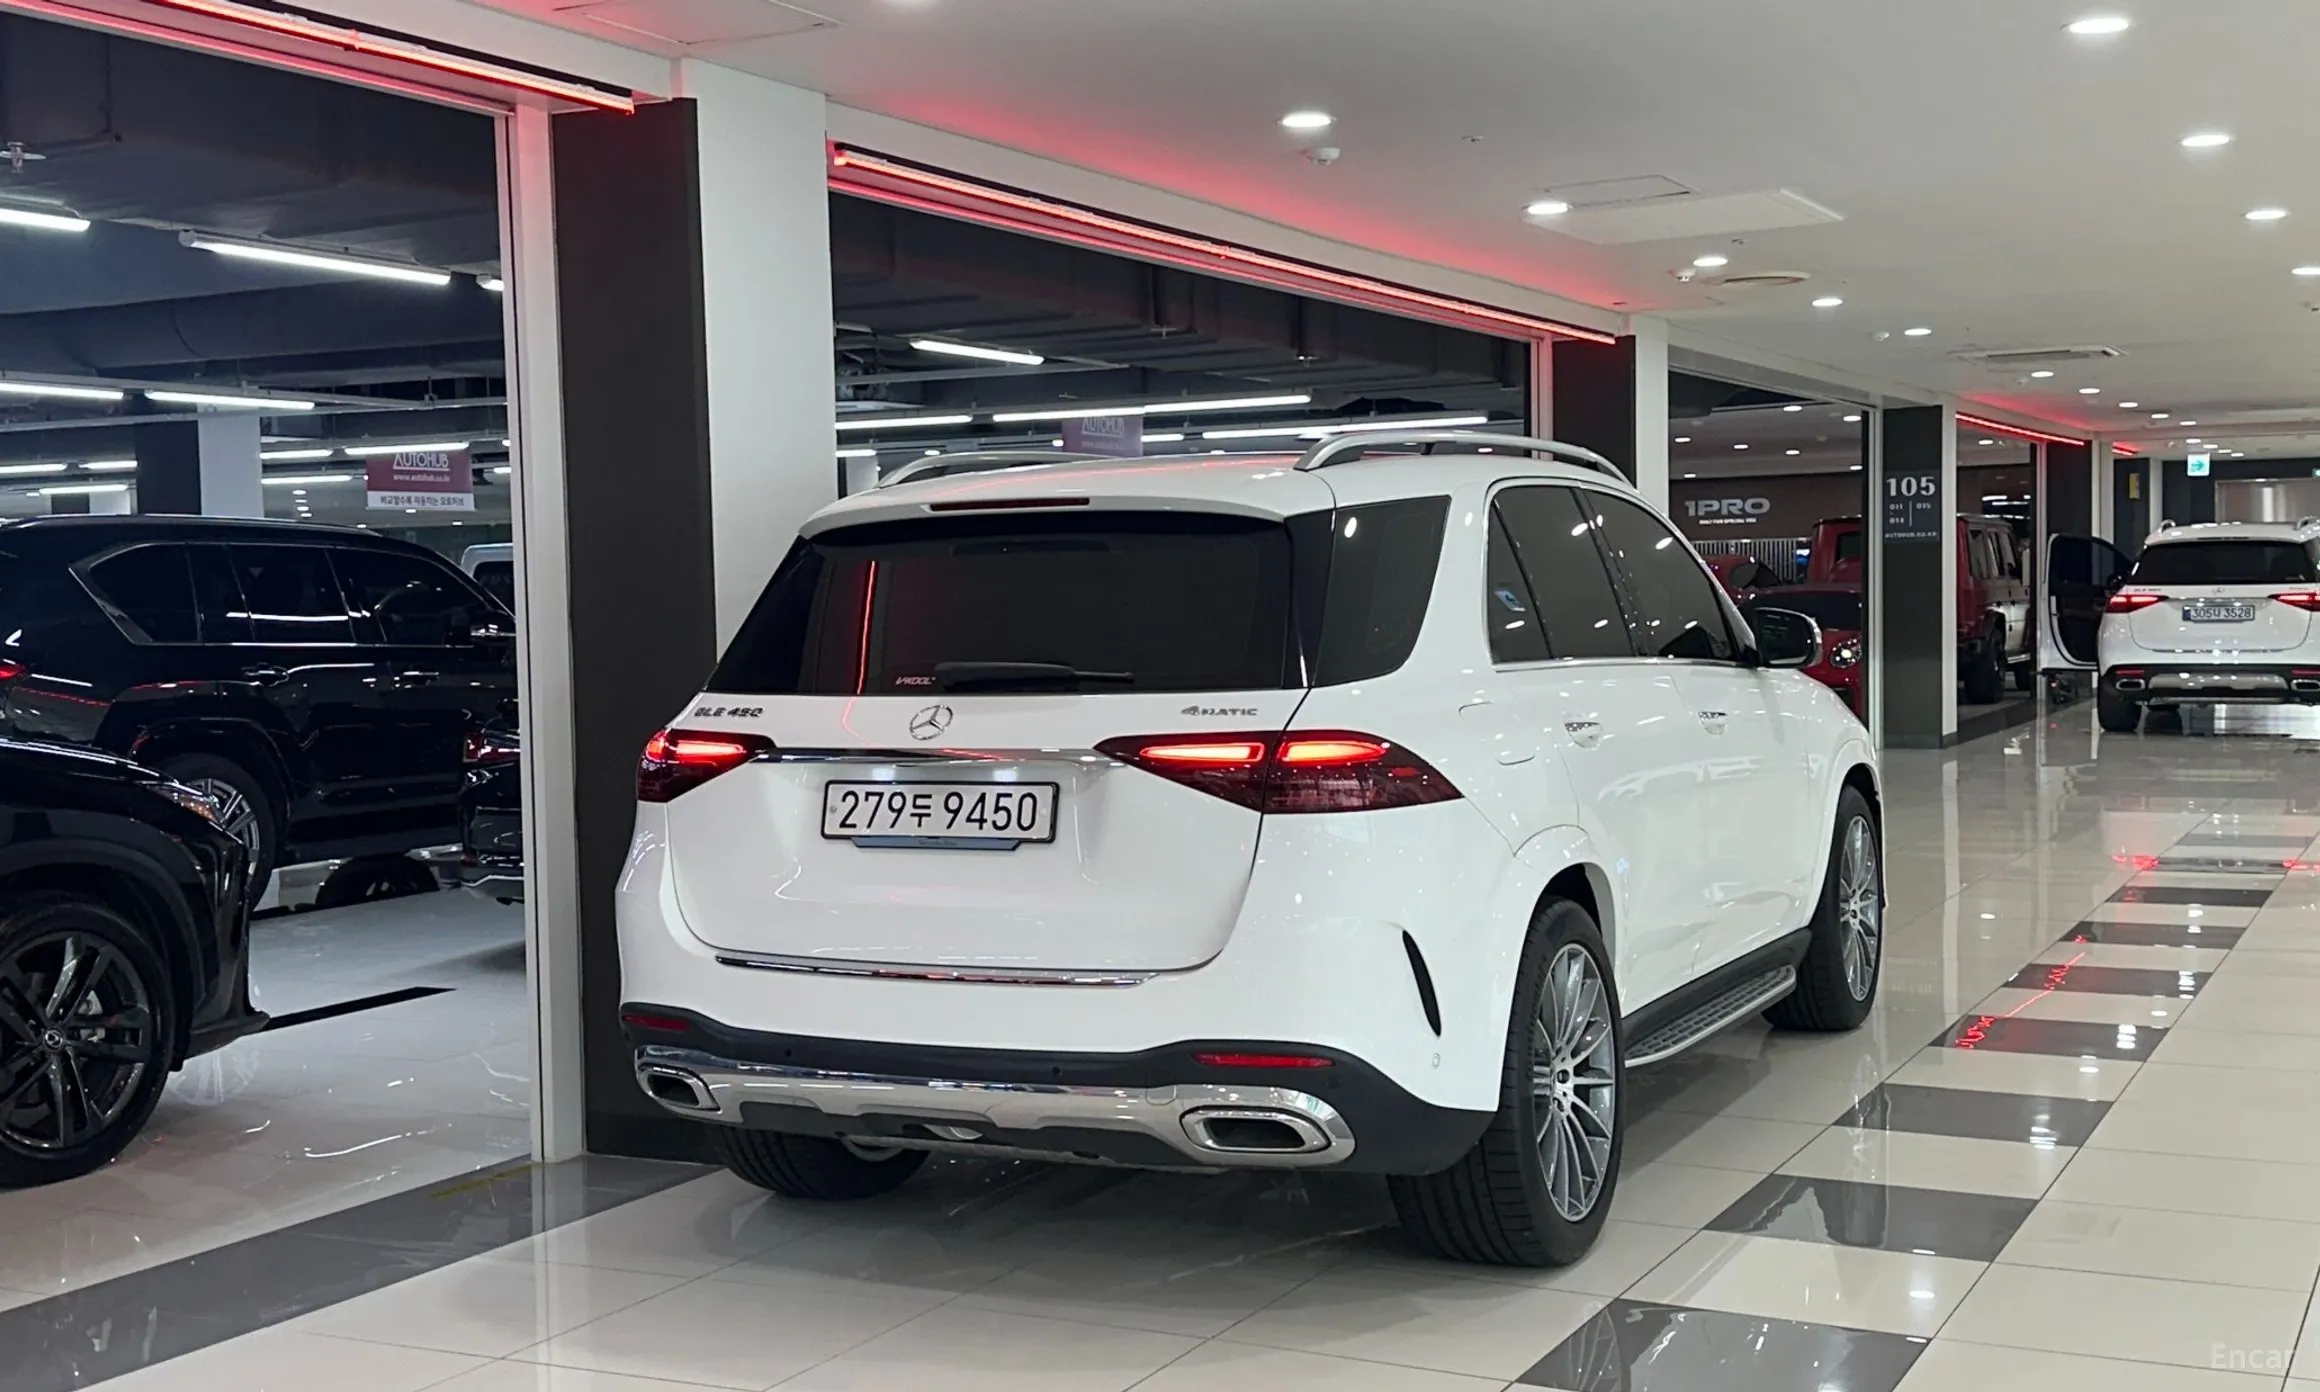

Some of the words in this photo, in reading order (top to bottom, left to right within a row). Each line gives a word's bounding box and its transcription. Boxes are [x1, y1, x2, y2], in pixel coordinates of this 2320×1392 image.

[393, 453, 449, 469] AUTOHUB
[1886, 476, 1936, 497] 105
[1684, 498, 1770, 516] 1PRO
[2223, 606, 2251, 618] 3528
[839, 790, 932, 830] 279두
[943, 791, 1038, 832] 9450
